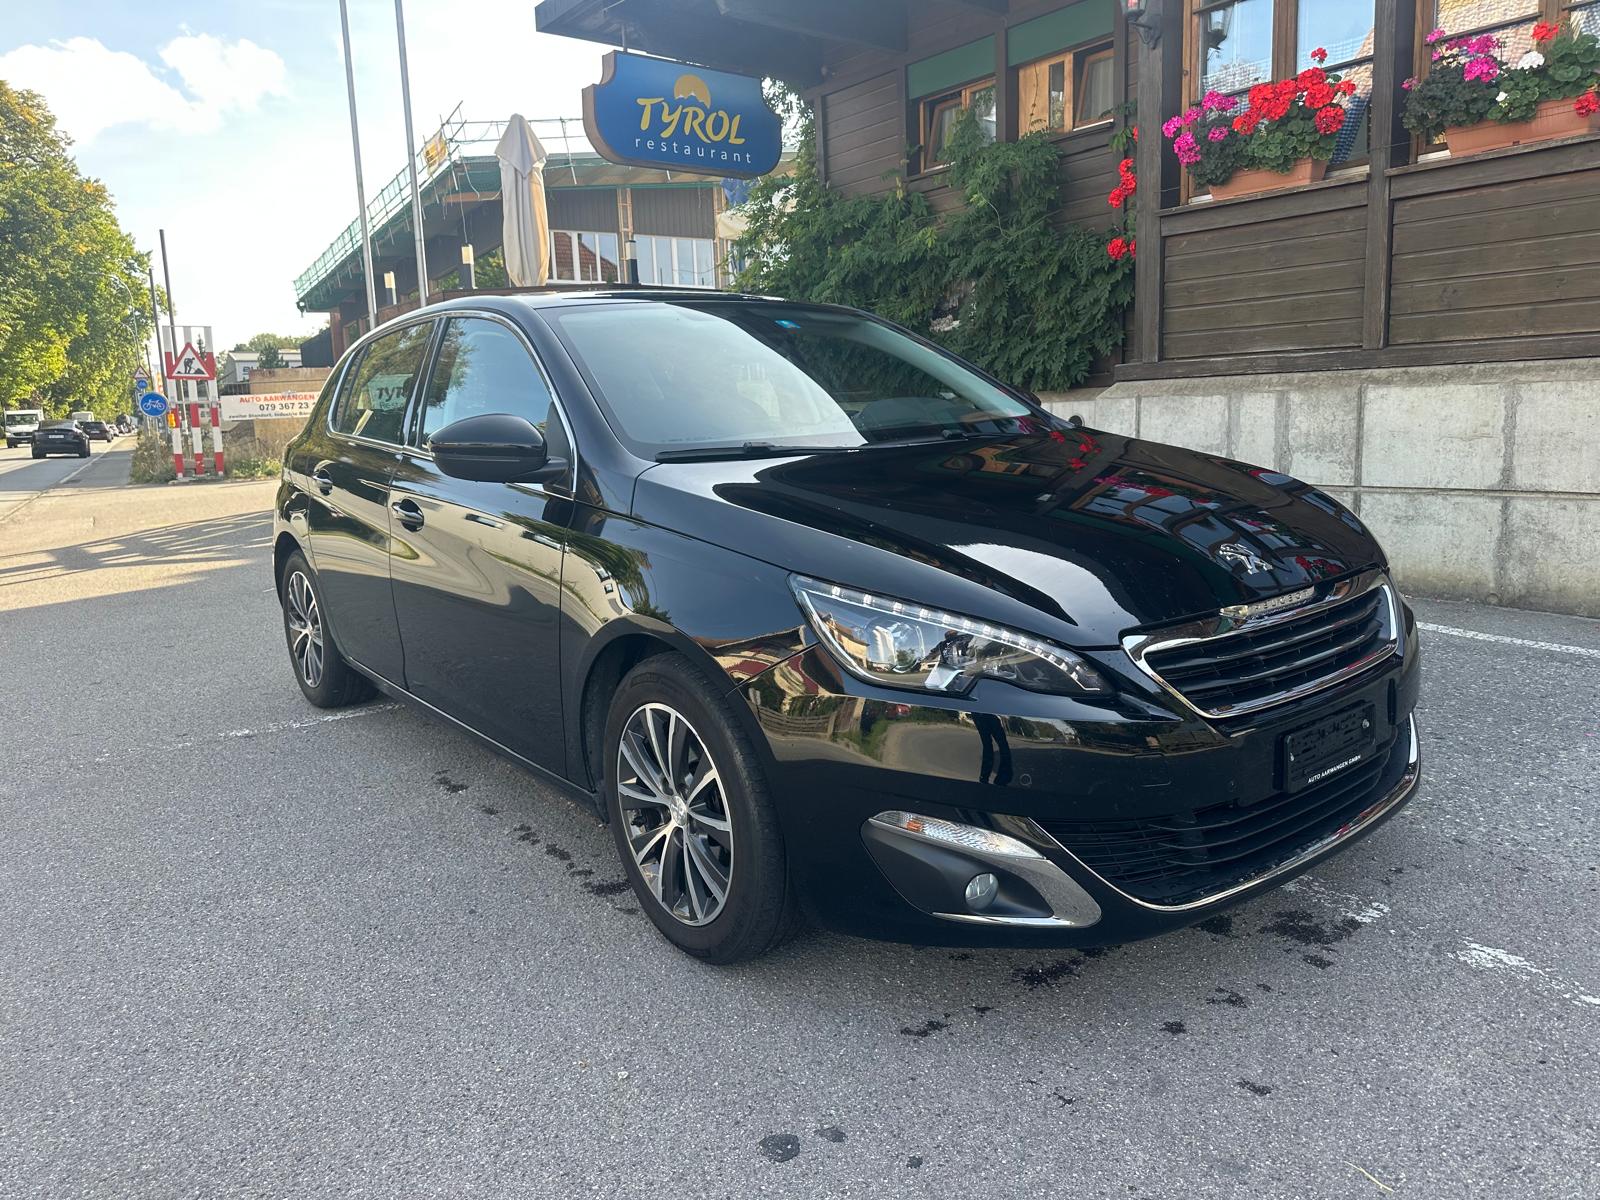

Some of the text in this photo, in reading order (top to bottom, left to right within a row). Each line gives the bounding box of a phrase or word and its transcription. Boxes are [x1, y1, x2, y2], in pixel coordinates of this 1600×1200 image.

[636, 98, 745, 144] TYROL
[635, 138, 751, 164] restaurant
[240, 393, 315, 403] AUTO AARWANGEN
[259, 403, 276, 411] 079
[279, 402, 295, 410] 367
[298, 402, 309, 410] 23
[1308, 773, 1321, 784] AUTO
[1321, 760, 1349, 778] AARWANGEN
